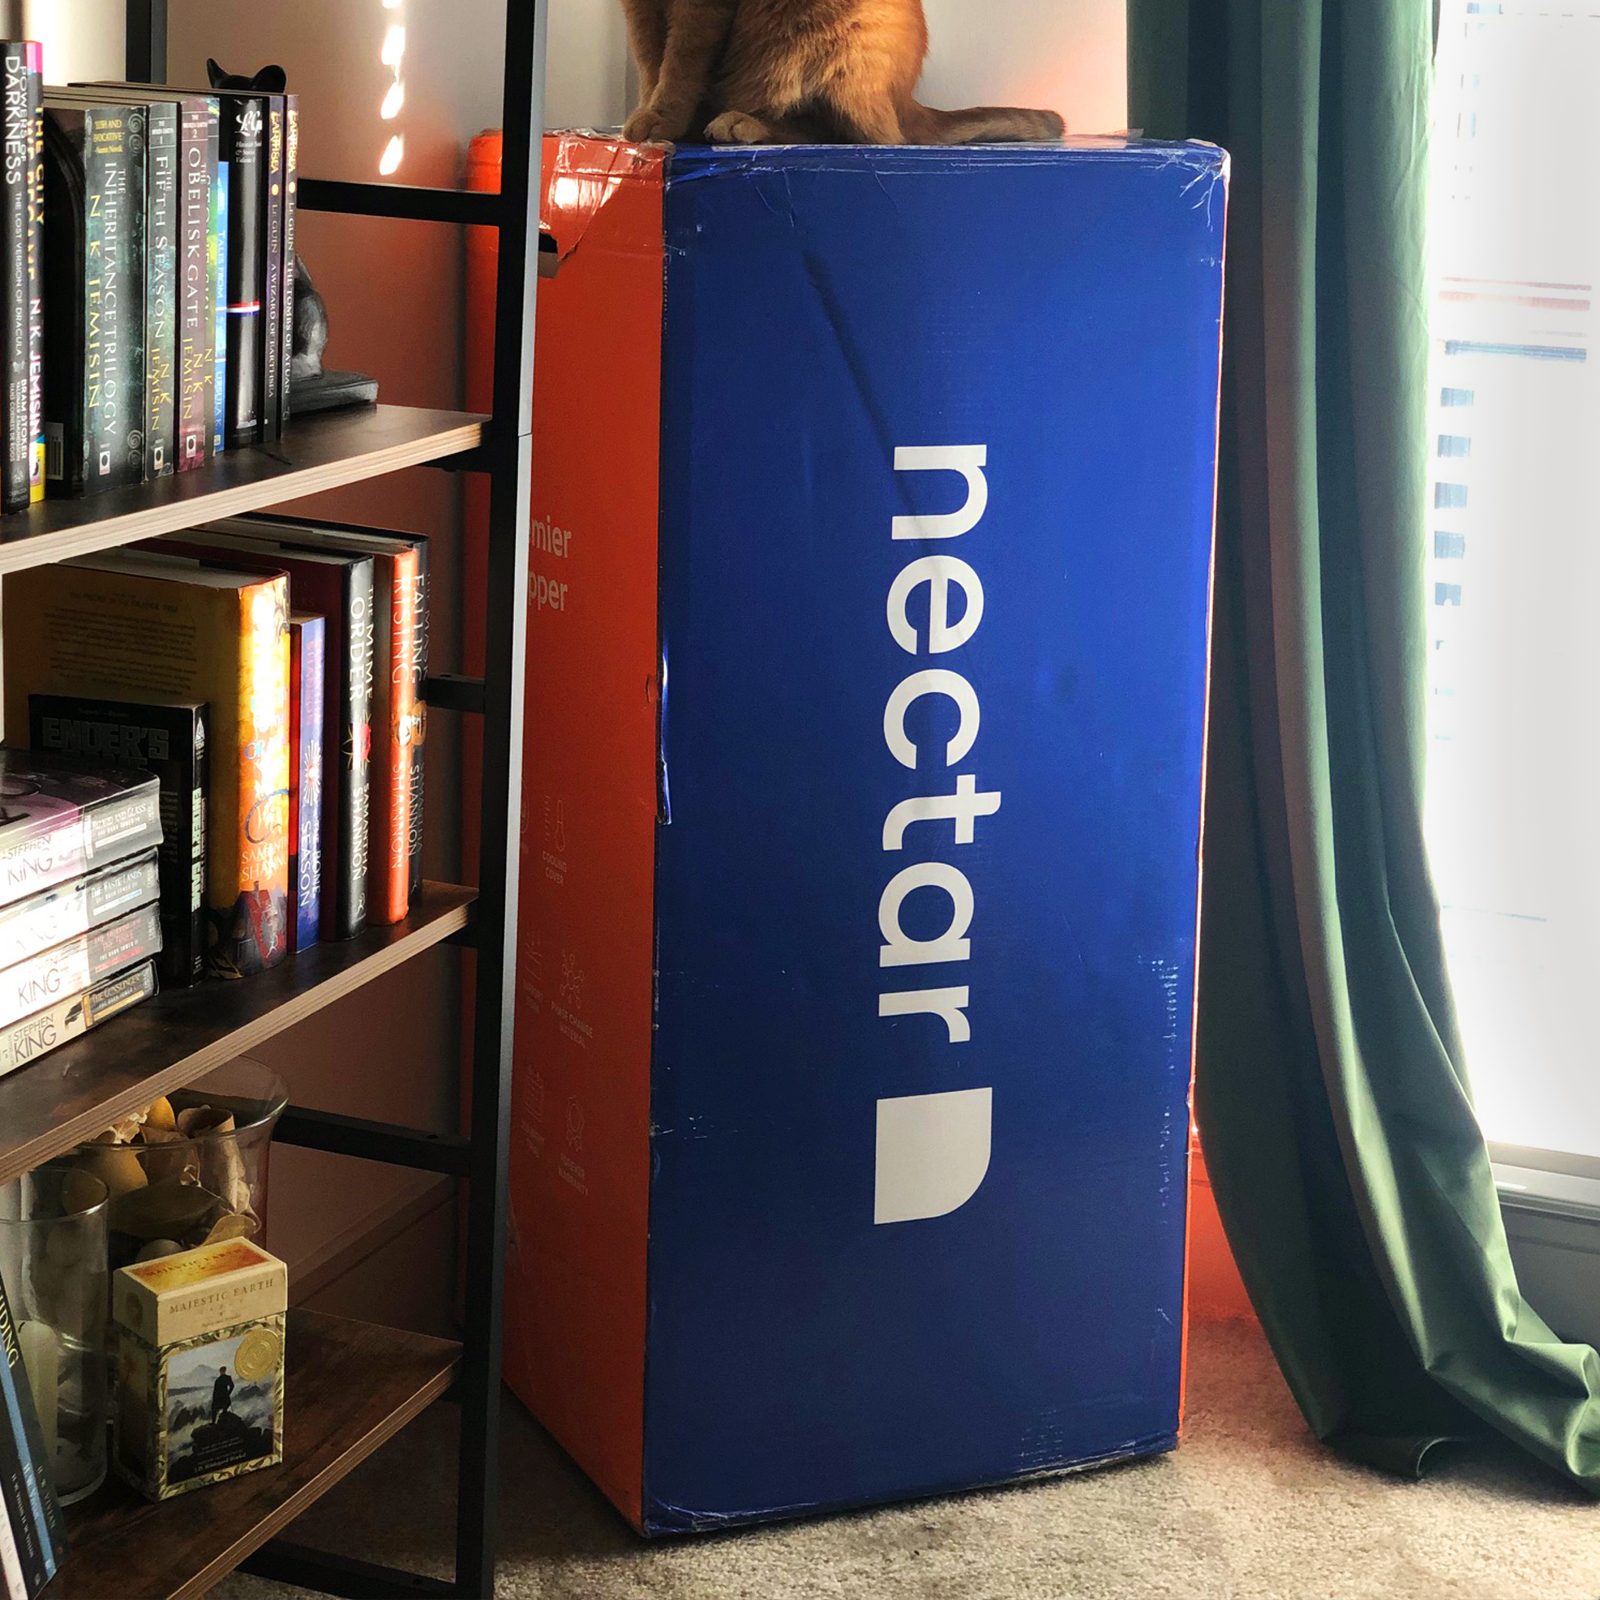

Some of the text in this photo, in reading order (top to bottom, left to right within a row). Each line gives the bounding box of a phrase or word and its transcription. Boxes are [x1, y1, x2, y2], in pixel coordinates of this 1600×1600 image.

[5, 57, 21, 185] DARKNESS
[89, 194, 102, 258] N K
[117, 168, 127, 194] THE
[154, 156, 169, 338] FIFTH SEASON
[185, 147, 201, 328] OBELISK GATE
[15, 307, 23, 356] DRACULA
[103, 162, 118, 434] INHERITANCE TRILOGY
[269, 273, 277, 319] WIZARD
[29, 299, 41, 436] N. K. JEMISIN
[530, 515, 572, 558] mier
[349, 596, 366, 702] ORDER
[365, 584, 375, 702] THE MIME
[392, 577, 412, 684] RISING
[42, 717, 169, 760] ENDER'S
[878, 443, 1002, 1044] nectar
[352, 786, 363, 881] SHANNON
[362, 782, 370, 877] SAMANTHA
[392, 761, 405, 869] SHANNON
[408, 764, 420, 857] SHANNON
[300, 820, 313, 906] SEASON
[312, 850, 321, 894] BONE
[13, 1013, 54, 1043] STEPHEN
[18, 967, 61, 1009] KING
[13, 1023, 57, 1063] KING
[169, 1291, 227, 1314] MAJESTIC
[233, 1278, 274, 1297] EARTH
